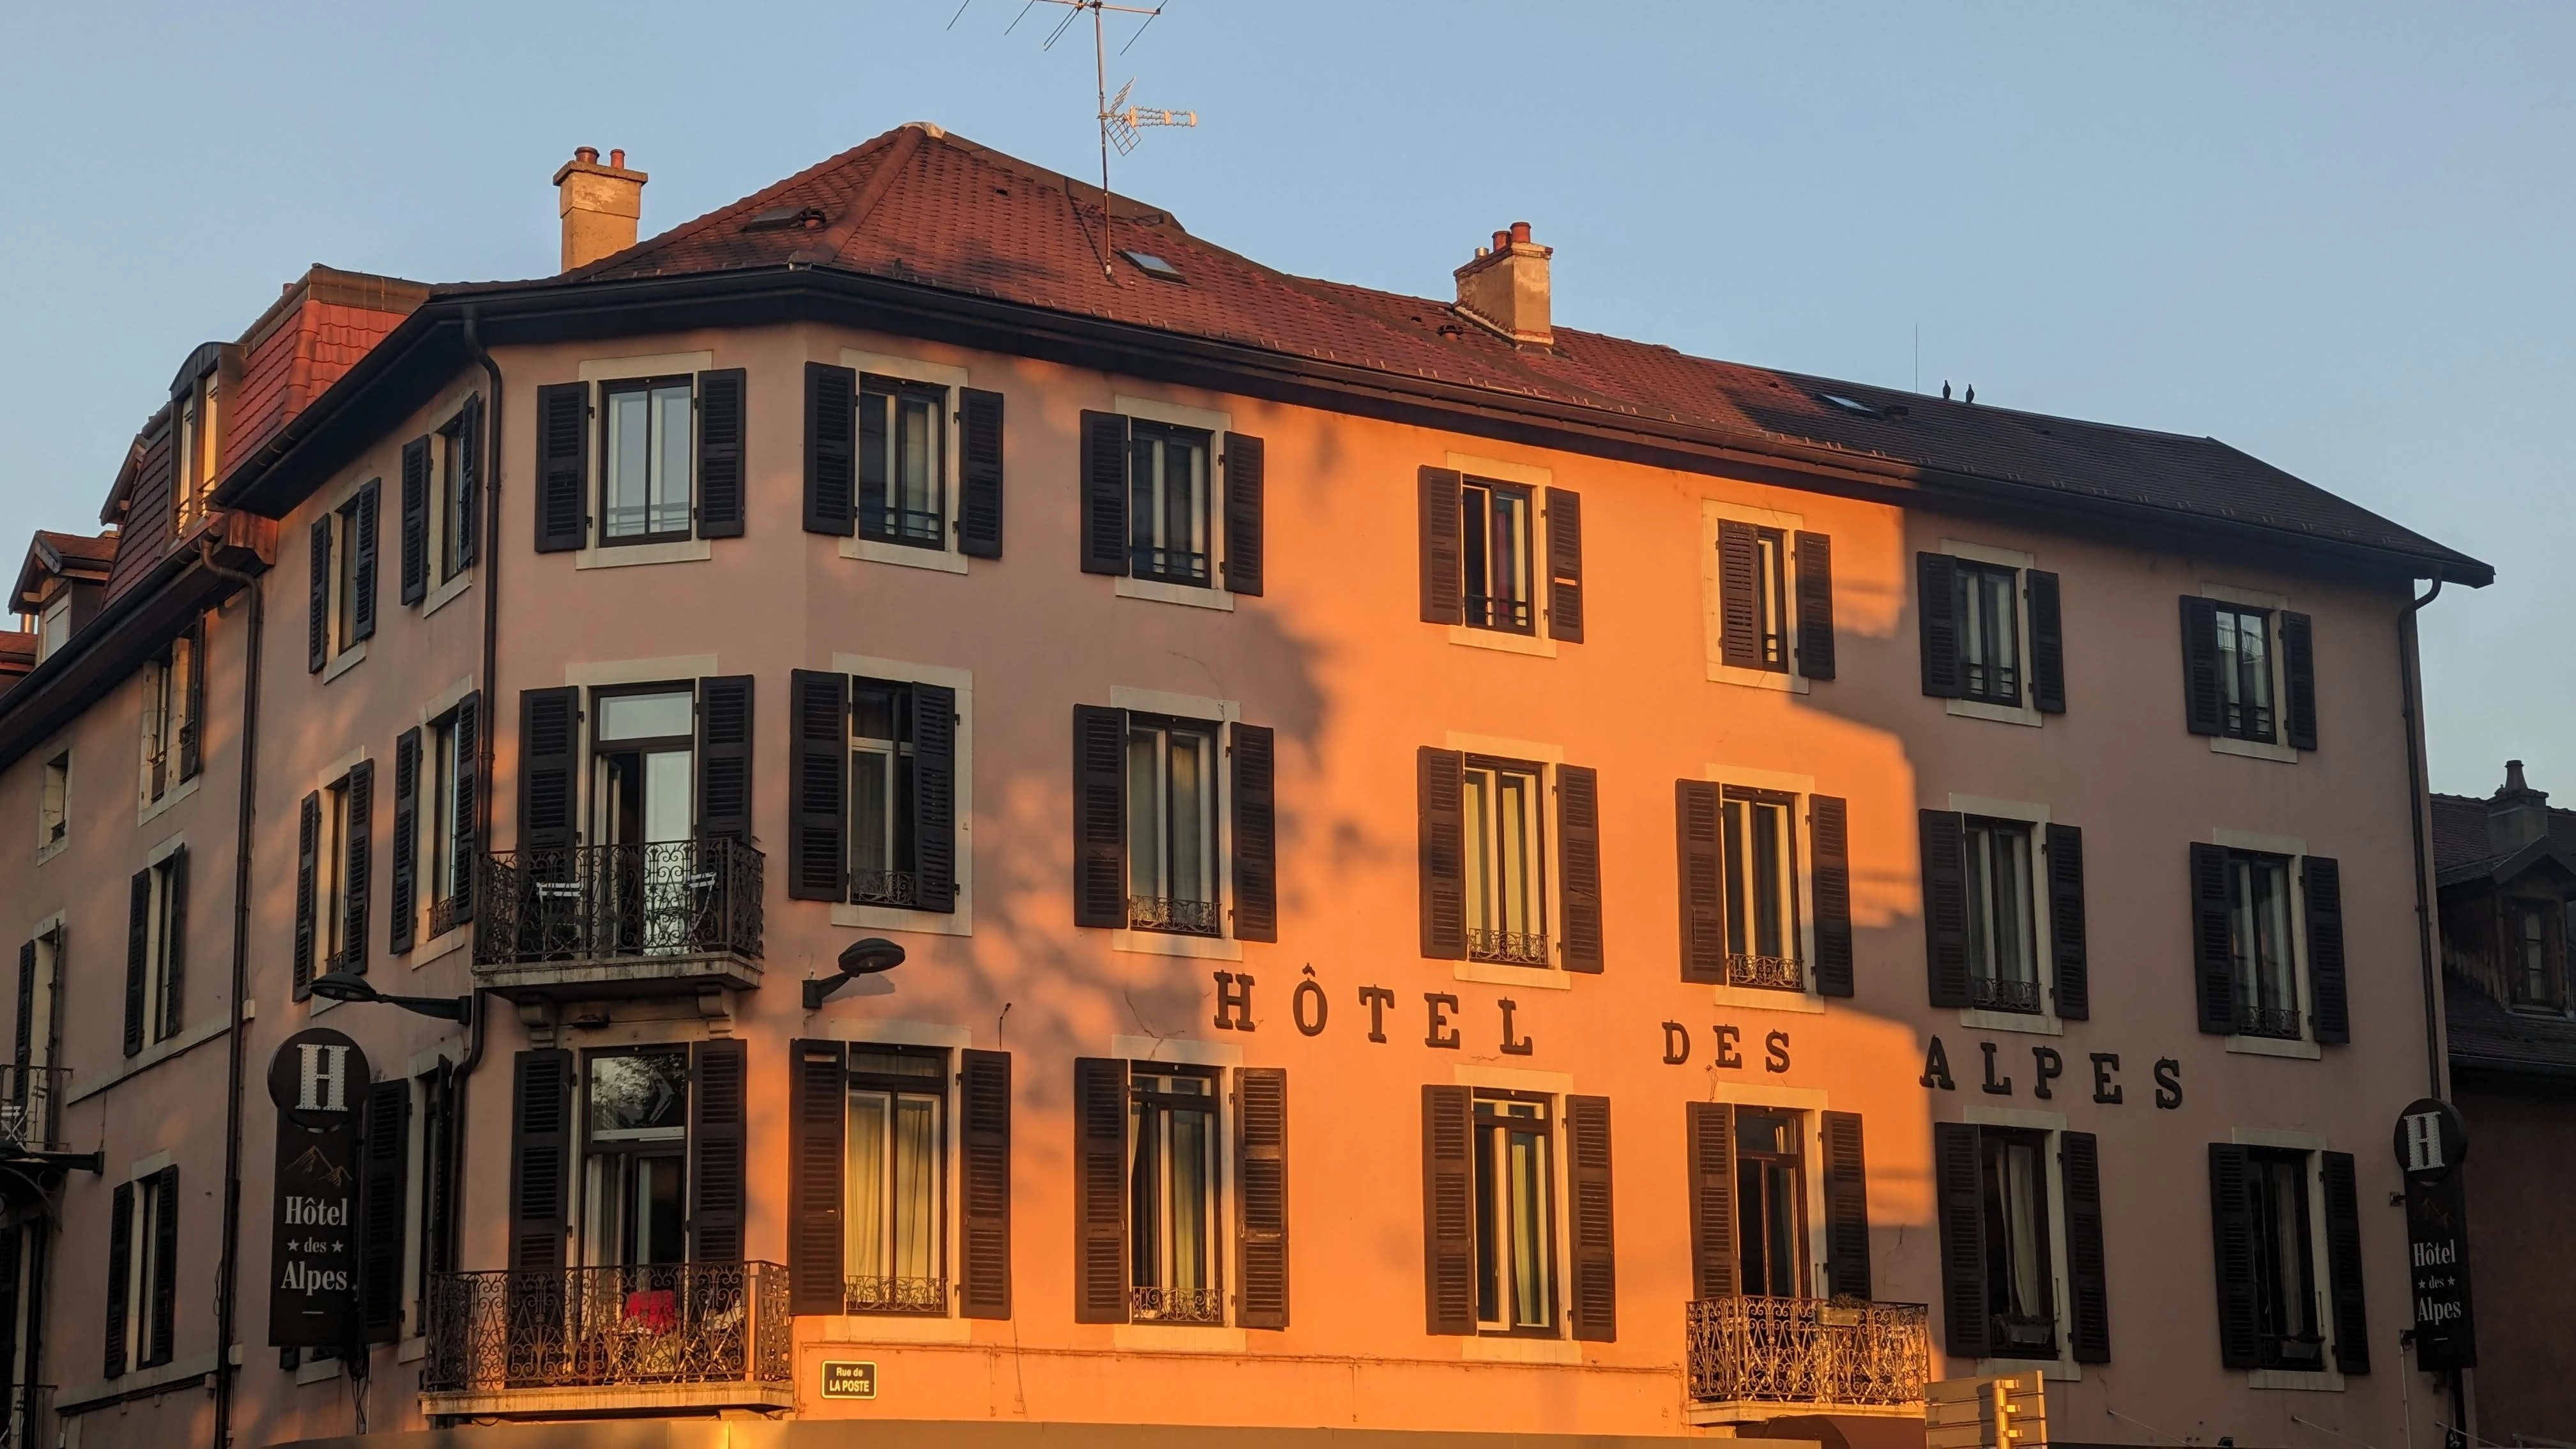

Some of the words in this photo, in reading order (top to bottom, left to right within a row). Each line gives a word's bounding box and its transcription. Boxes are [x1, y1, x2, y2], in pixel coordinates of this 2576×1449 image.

[1213, 963, 1533, 1056] HÔTEL
[1661, 1020, 1790, 1073] DES
[1919, 1035, 2183, 1110] ALPES
[295, 1043, 350, 1112] H
[2404, 1111, 2446, 1172] H
[284, 1196, 348, 1227] Hôtel
[303, 1236, 327, 1254] des
[2412, 1239, 2456, 1267] Hôtel
[280, 1261, 348, 1297] Alpes
[2428, 1275, 2444, 1289] des
[2417, 1297, 2462, 1326] Alpes
[829, 1380, 841, 1392] LA
[842, 1380, 870, 1392] POSTE
[836, 1367, 851, 1376] Rue
[853, 1368, 863, 1377] de
